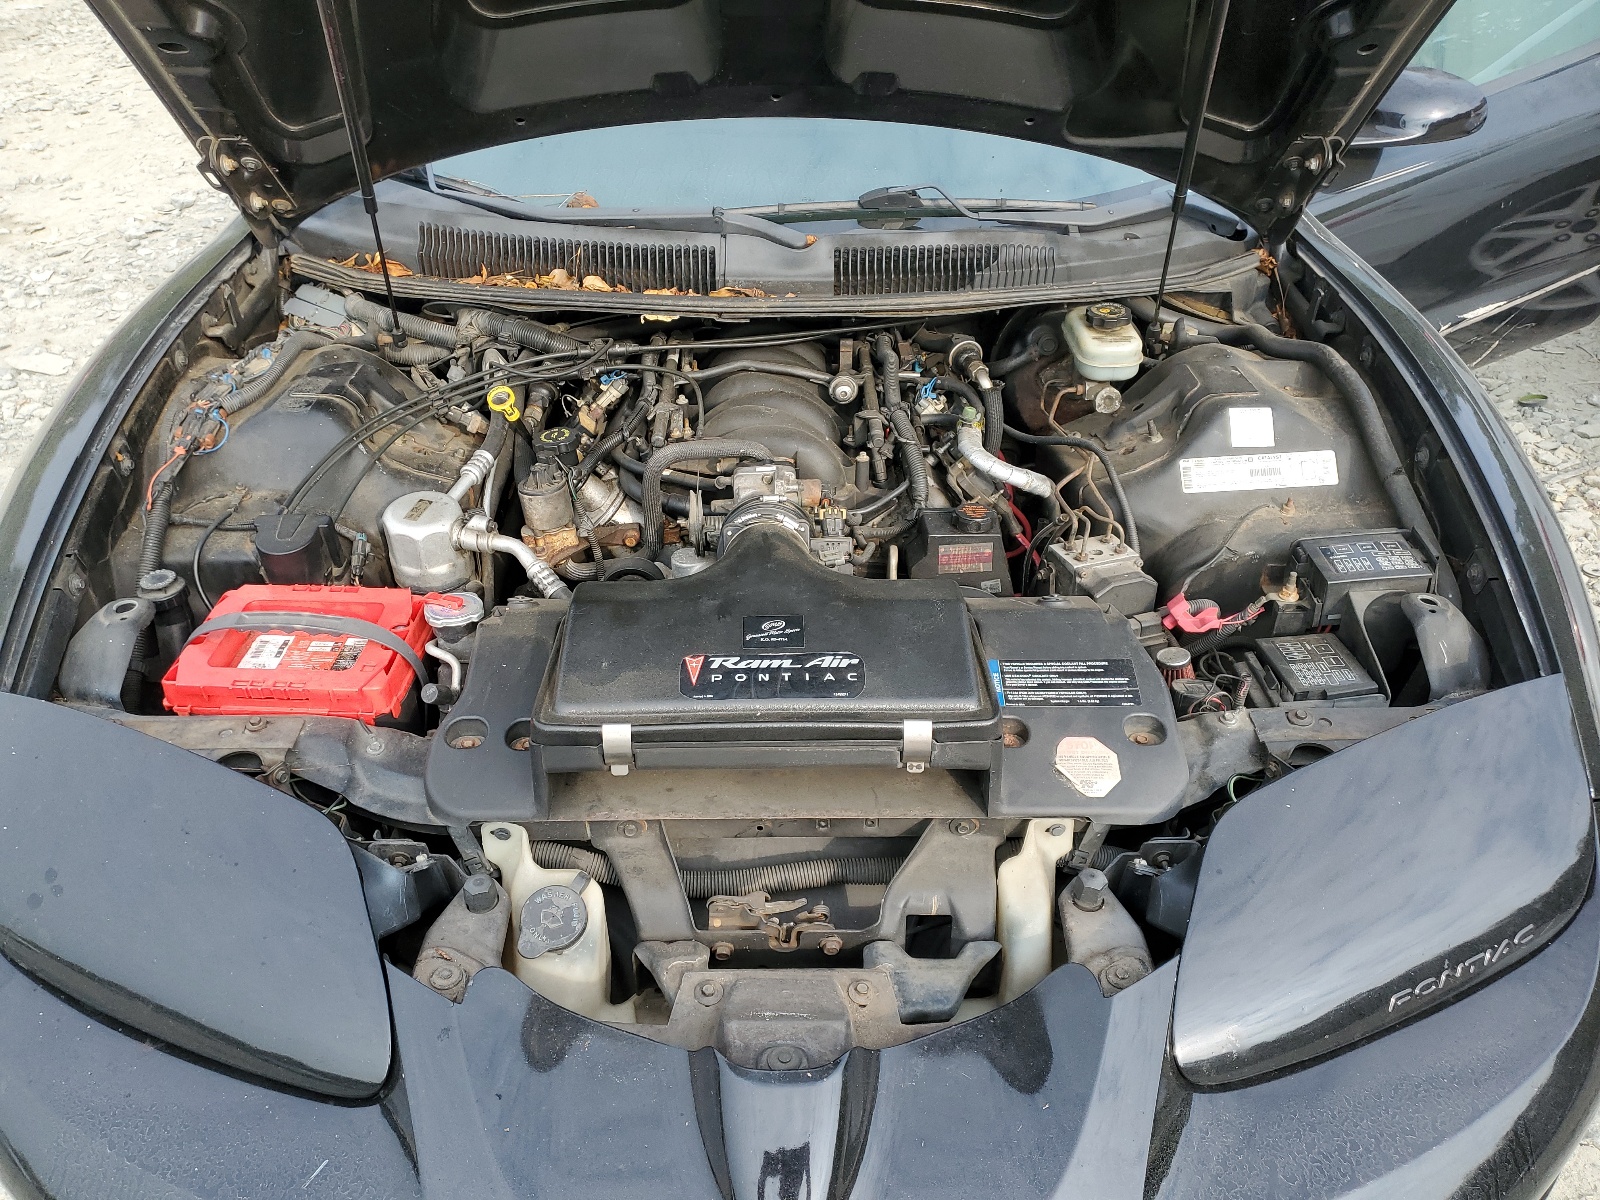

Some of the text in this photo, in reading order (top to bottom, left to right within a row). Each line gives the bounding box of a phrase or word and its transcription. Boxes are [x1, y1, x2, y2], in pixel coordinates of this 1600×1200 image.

[708, 655, 859, 669] Ram Air
[711, 672, 858, 682] PONTIAC
[992, 672, 1001, 692] NOTICE
[1388, 923, 1534, 1012] PONTIAC
